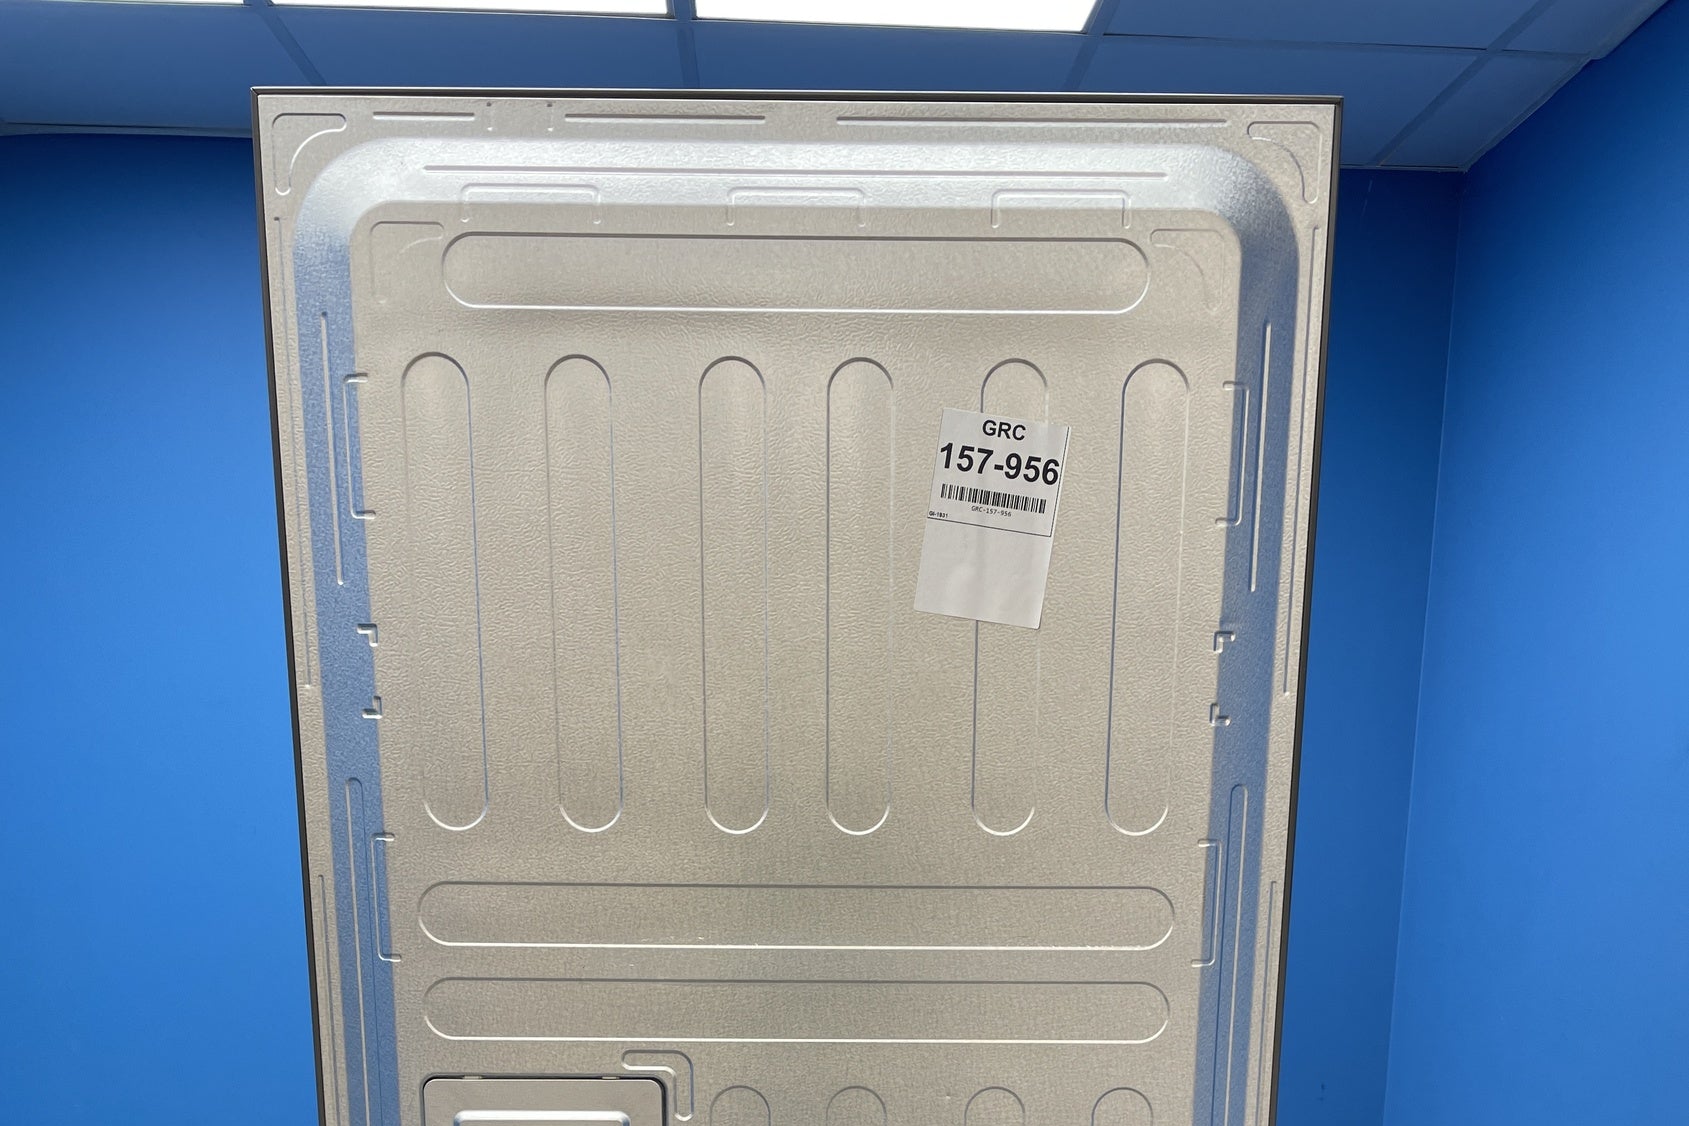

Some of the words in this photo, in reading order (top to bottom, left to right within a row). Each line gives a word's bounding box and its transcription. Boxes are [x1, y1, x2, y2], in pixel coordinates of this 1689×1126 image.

[982, 419, 1026, 441] GRC
[940, 442, 1060, 485] 157-956
[971, 505, 1012, 517] GRC-157-956
